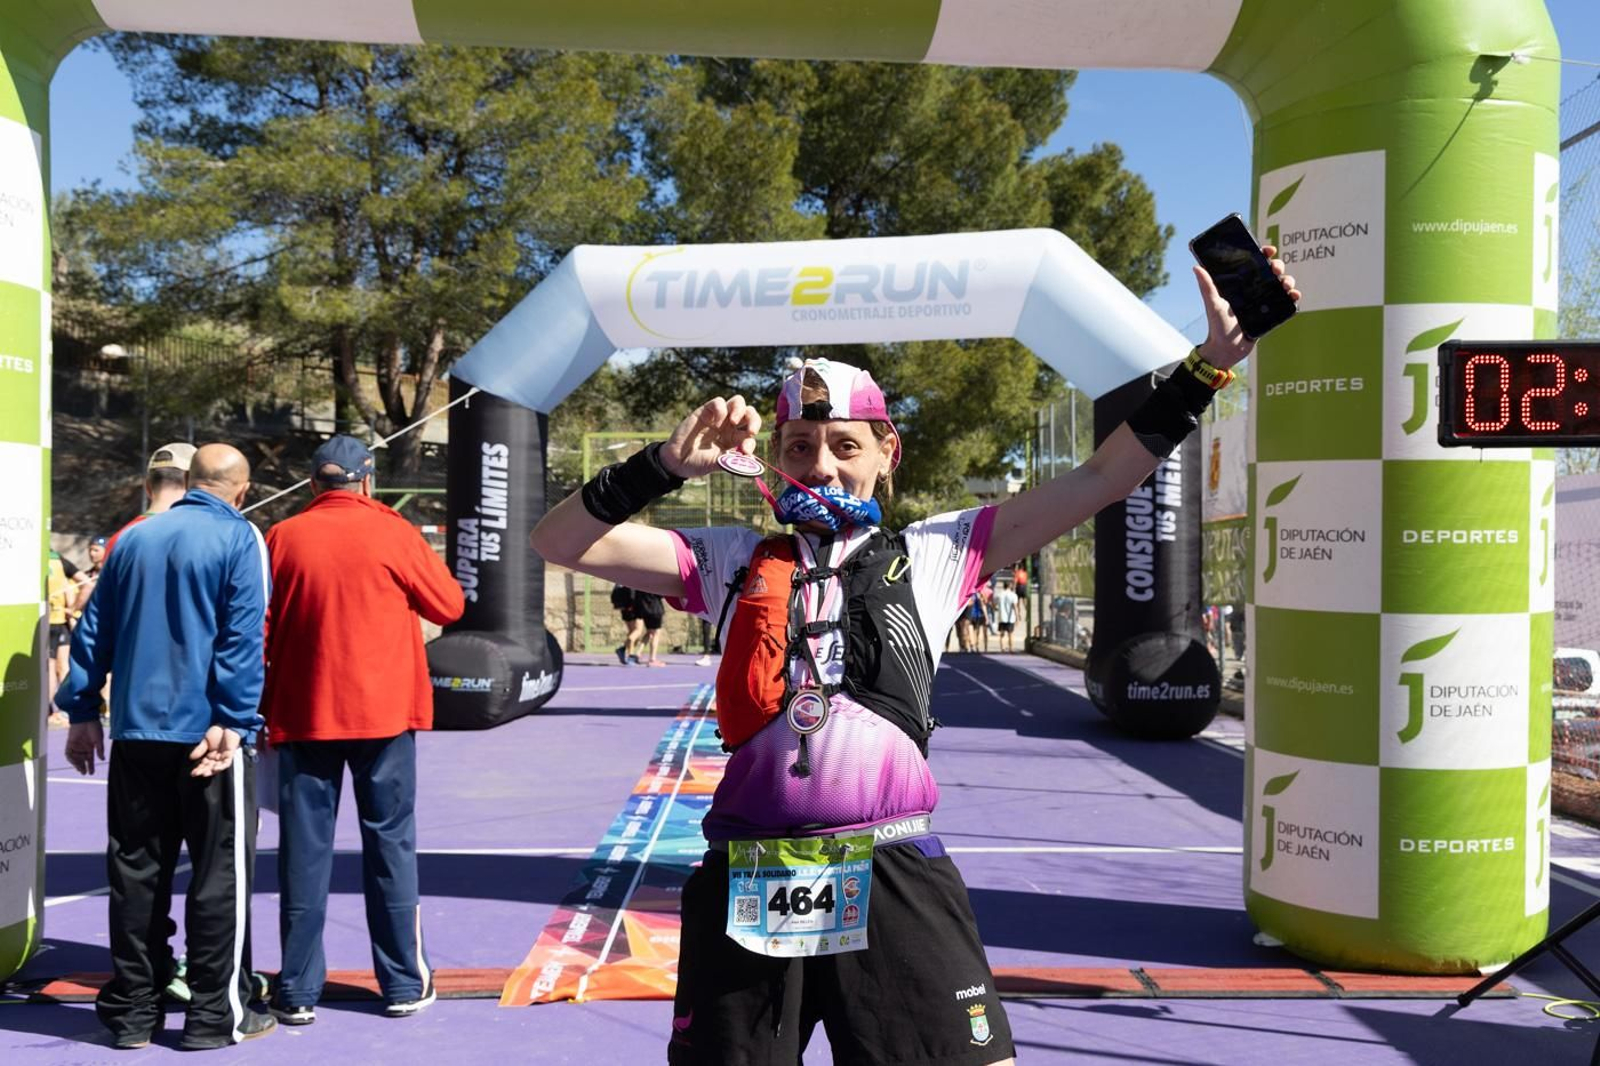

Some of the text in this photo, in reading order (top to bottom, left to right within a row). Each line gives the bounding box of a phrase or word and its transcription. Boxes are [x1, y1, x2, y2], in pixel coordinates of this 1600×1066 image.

[1282, 222, 1368, 247] DIPUTACIÓN
[1412, 219, 1518, 235] www.dipujaen.es
[1282, 245, 1335, 264] DE JAÉN
[646, 259, 970, 309] TIME2RUN
[791, 303, 971, 322] CRONOMETRAJE DEPORTIVO
[1266, 377, 1364, 396] DEPORTES
[475, 442, 509, 562] TUS LÍMITES
[1156, 510, 1177, 542] TUS
[1280, 527, 1366, 543] DIPUTACIÓN
[1125, 486, 1154, 602] CONSIGUE
[1402, 530, 1519, 544] DEPORTES
[1280, 546, 1333, 561] DE JAÉN
[1127, 682, 1210, 699] time2run.es
[1266, 675, 1354, 697] www.dipujaen.es
[1430, 683, 1518, 699] DIPUTACIÓN
[1430, 703, 1493, 720] DE JAÉN
[1277, 821, 1363, 848] DIPUTACIÓN
[1277, 839, 1330, 862] DE JAÉN
[1400, 838, 1515, 854] DEPORTES
[767, 884, 835, 917] 464
